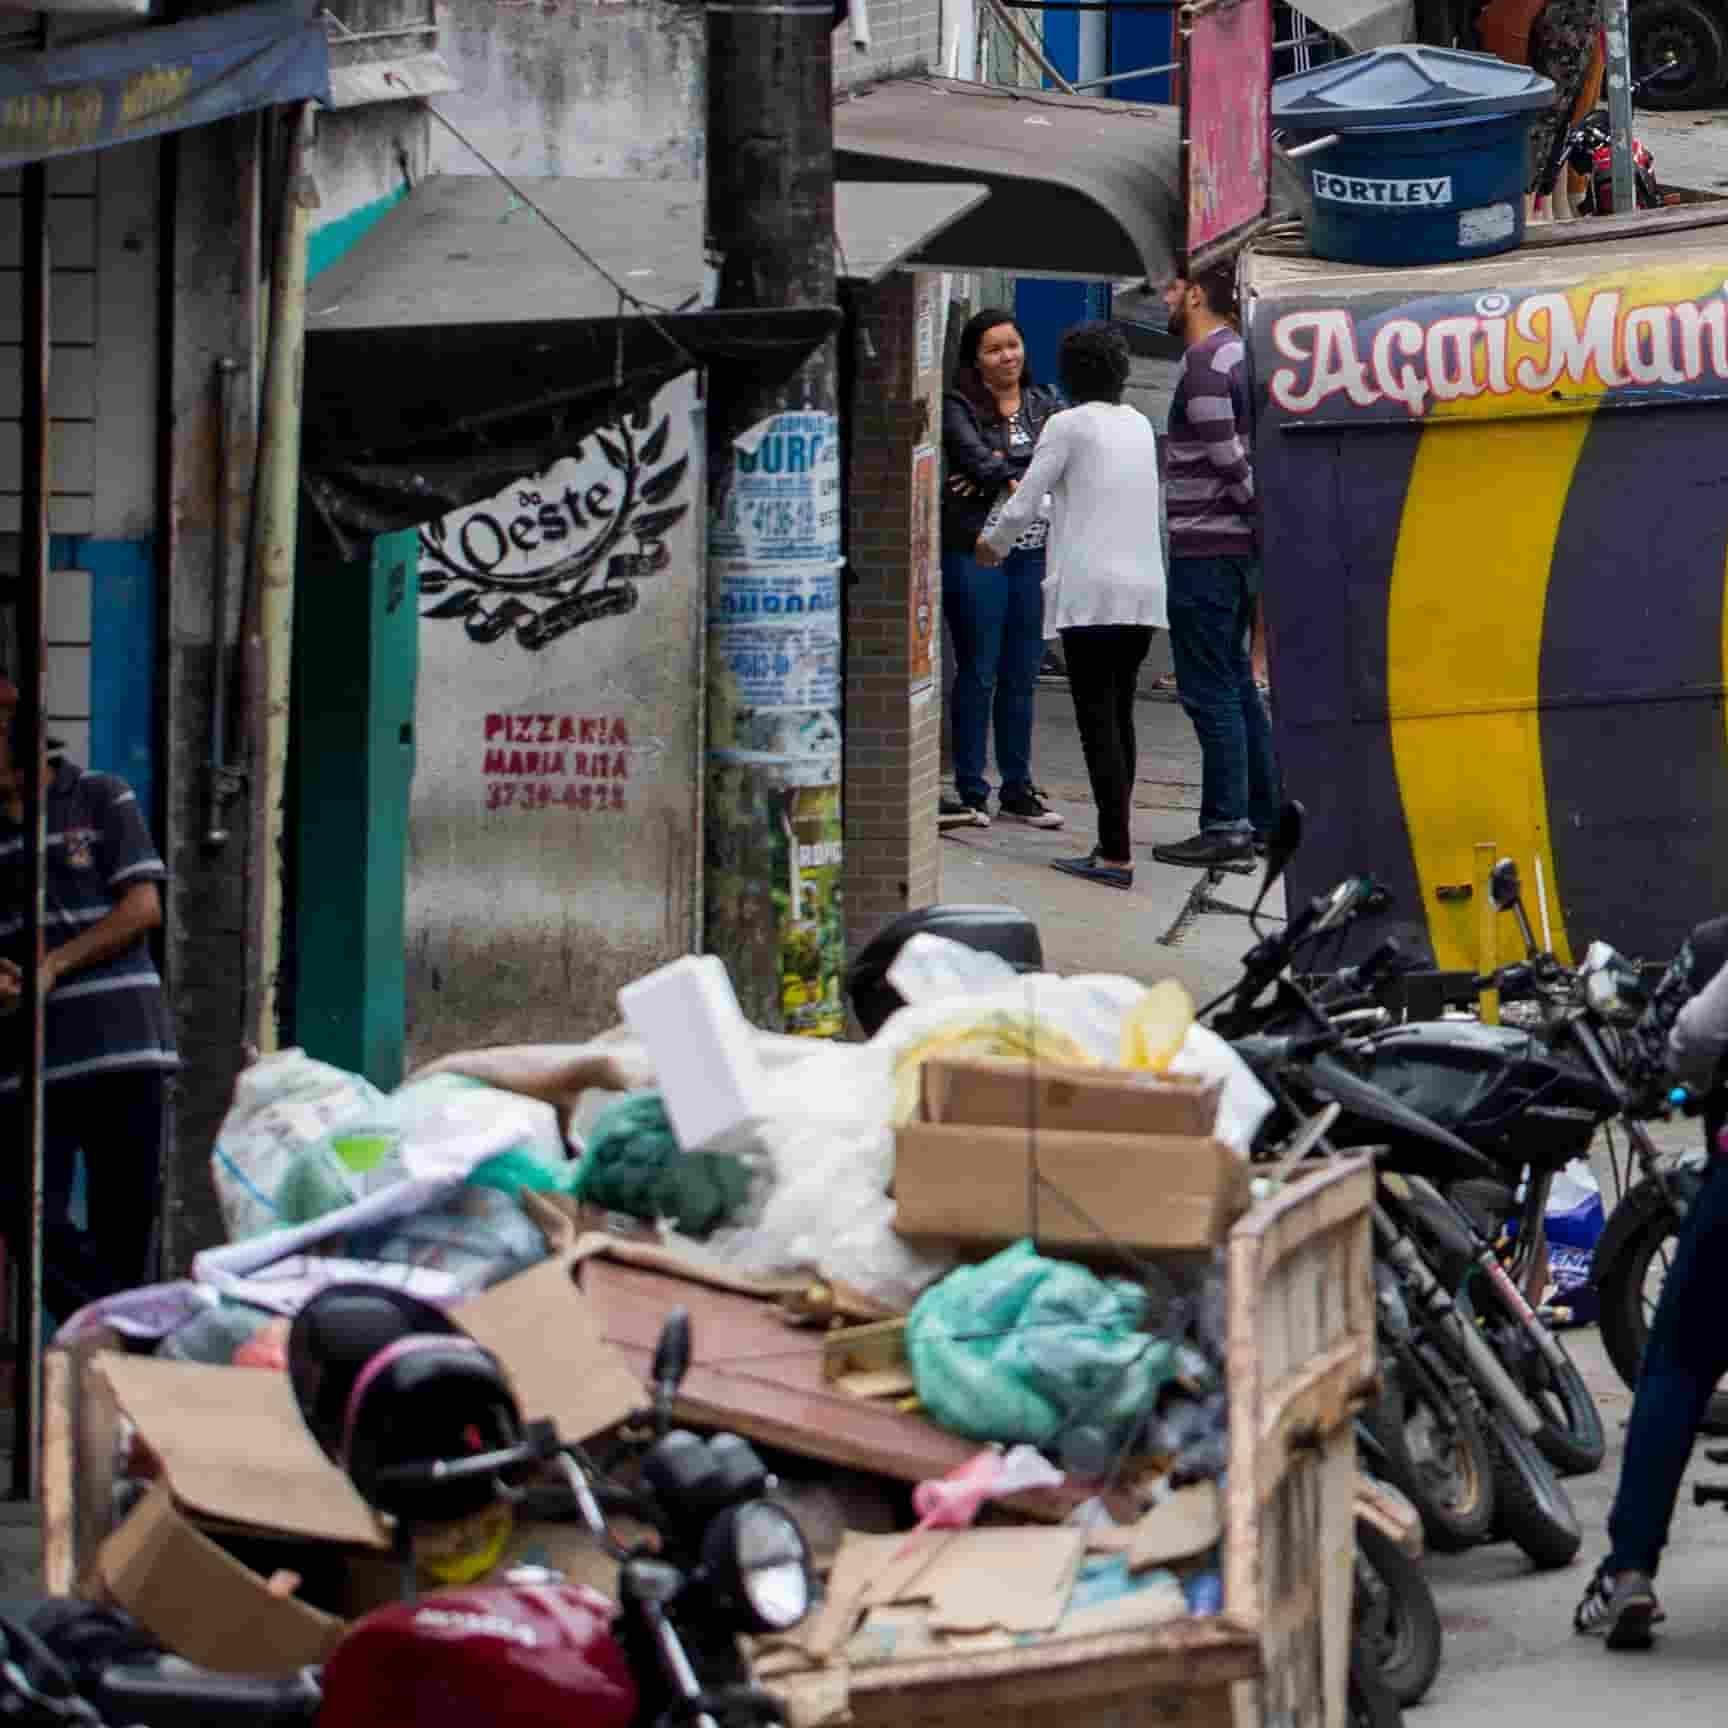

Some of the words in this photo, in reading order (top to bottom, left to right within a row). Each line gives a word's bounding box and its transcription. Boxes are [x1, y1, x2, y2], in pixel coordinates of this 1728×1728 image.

[1315, 174, 1446, 204] FORTLEV
[461, 483, 613, 572] Oeste
[483, 714, 630, 745] PIZZARIA
[481, 749, 564, 777] MARIA
[574, 751, 630, 779] RITA
